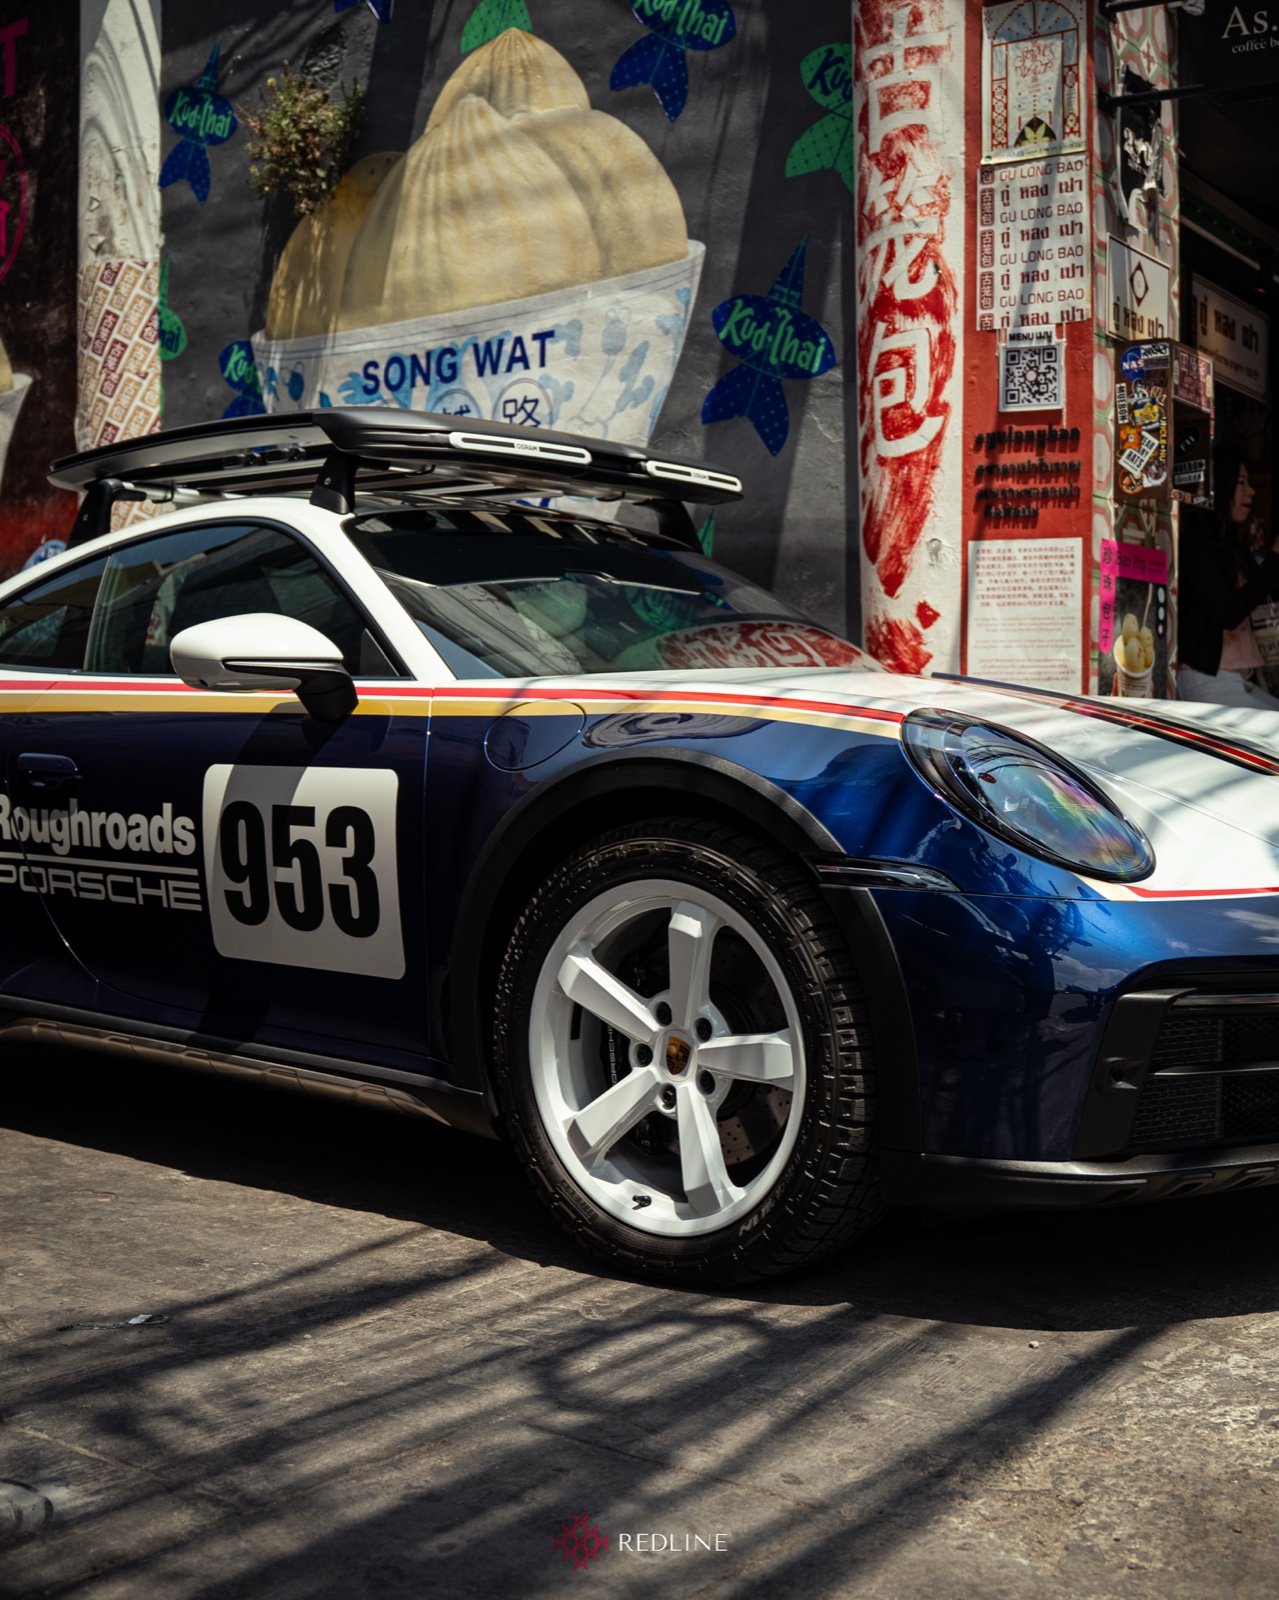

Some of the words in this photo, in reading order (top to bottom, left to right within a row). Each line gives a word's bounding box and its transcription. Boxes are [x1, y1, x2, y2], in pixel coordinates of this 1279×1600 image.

[1000, 170, 1016, 182] GU
[1020, 164, 1052, 179] LONG
[1057, 160, 1083, 173] BAO
[1000, 211, 1016, 224] GU
[1020, 206, 1052, 221] LONG
[1057, 202, 1083, 216] BAO
[1000, 253, 1017, 266] GU
[1021, 249, 1053, 263] LONG
[1058, 245, 1084, 259] BAO
[1000, 295, 1016, 308] GU
[1020, 291, 1053, 306] LONG
[1058, 288, 1084, 302] BAO
[1009, 333, 1034, 341] MENU
[362, 347, 458, 396] SONG
[473, 330, 556, 378] WAT
[1122, 359, 1145, 371] NAS
[219, 799, 381, 939] 953
